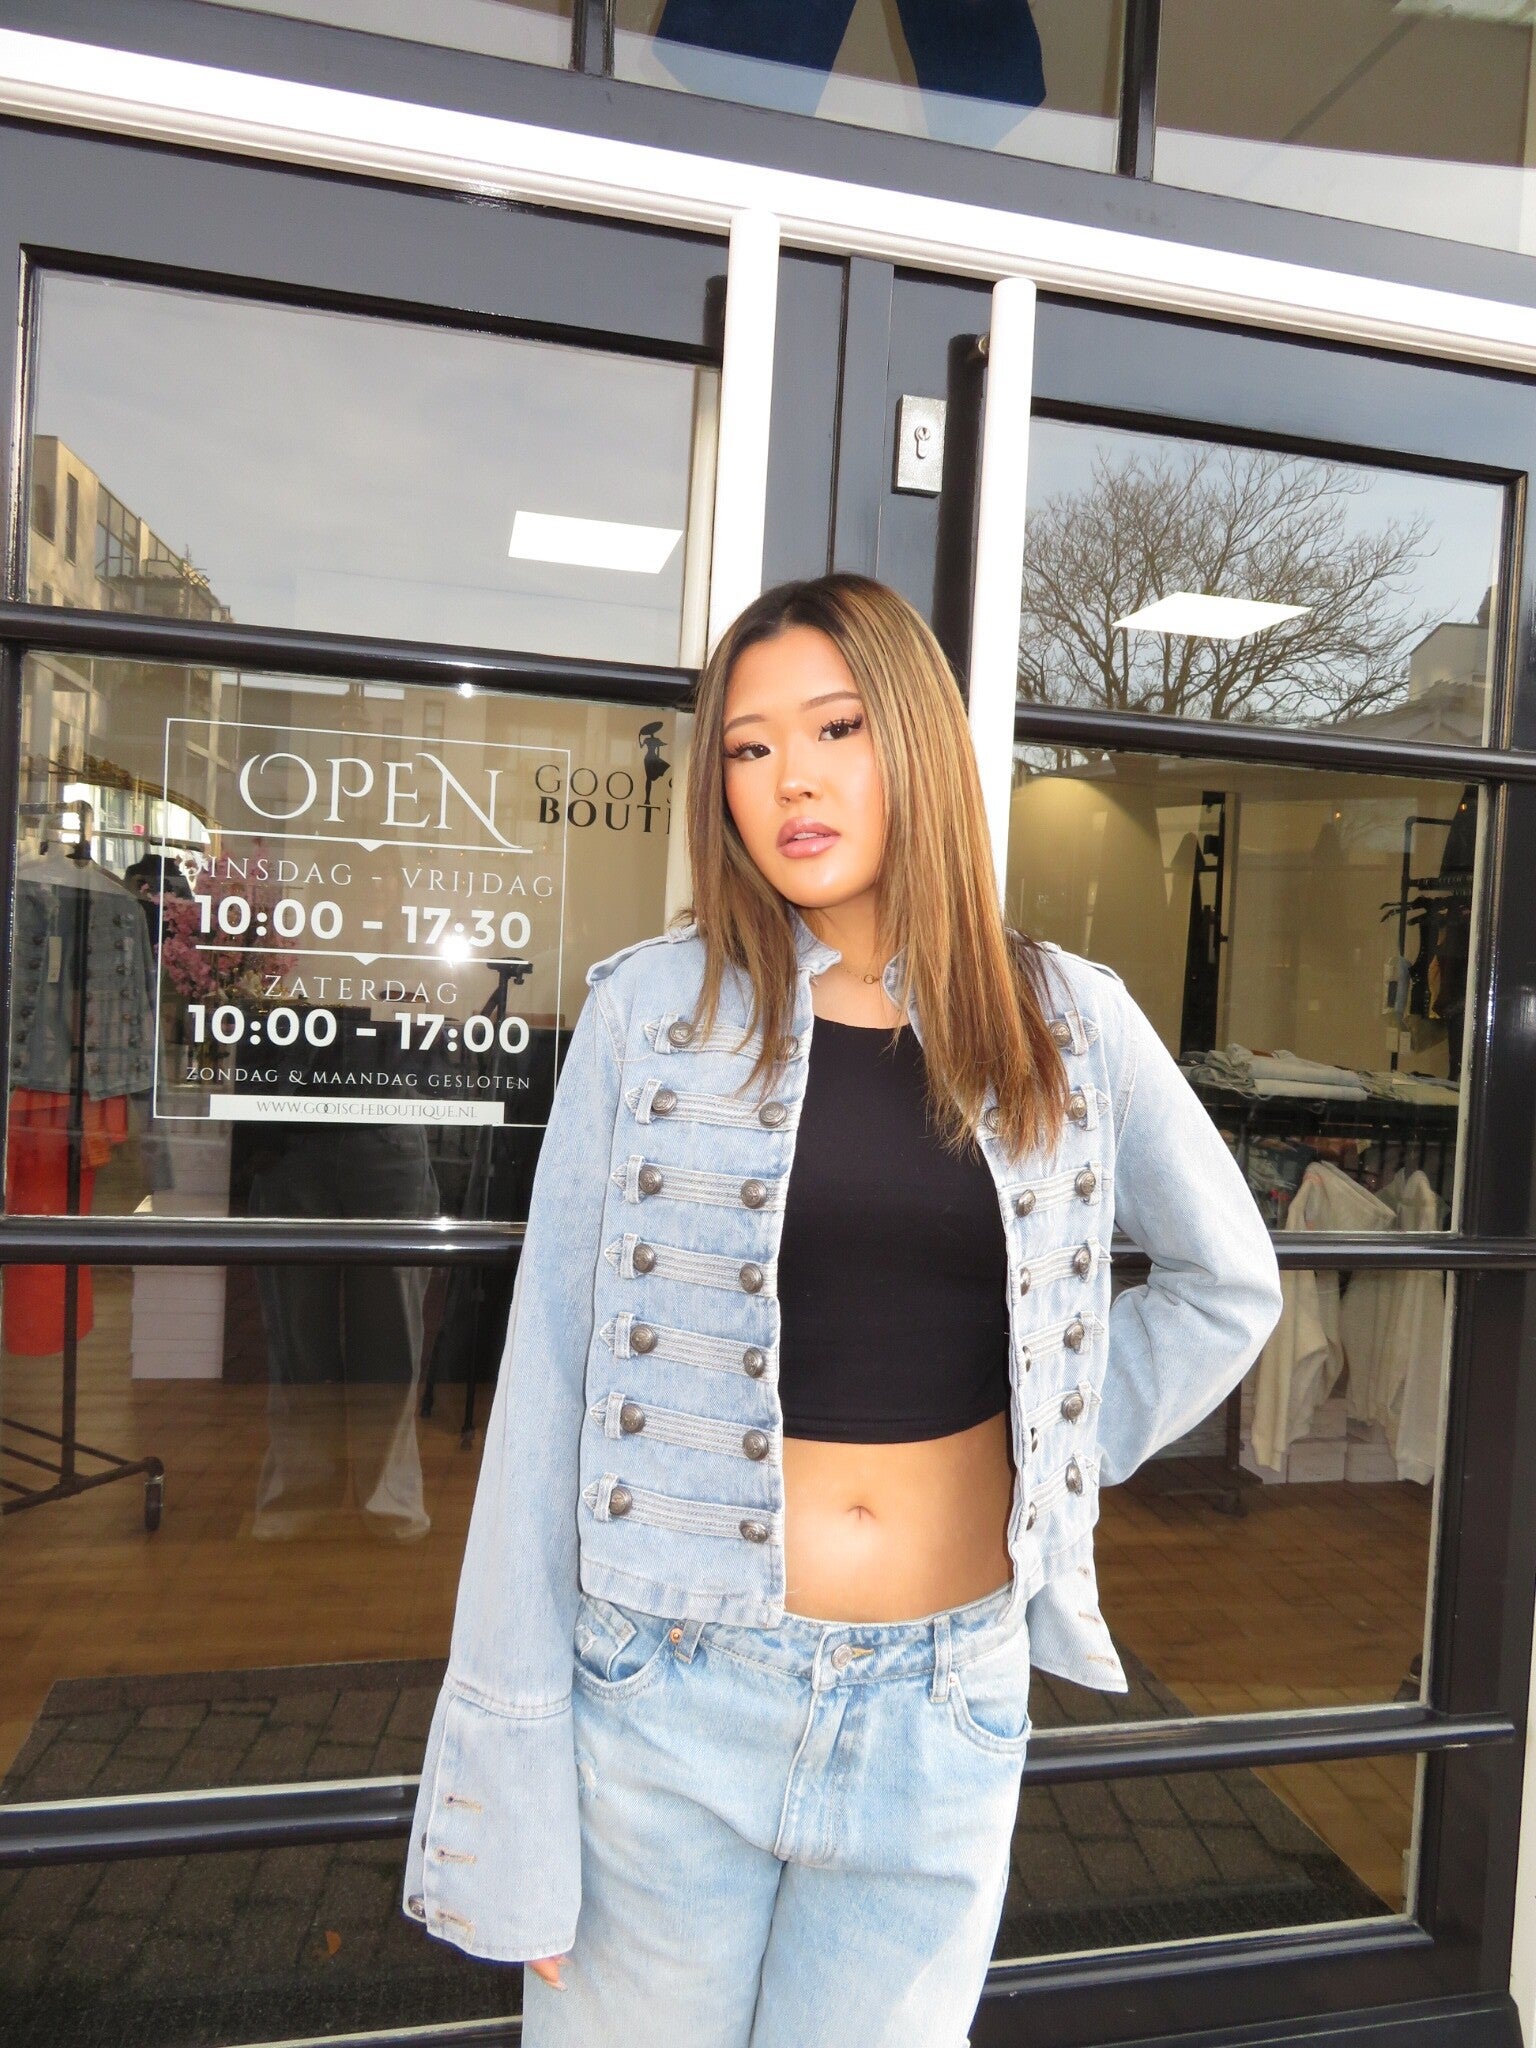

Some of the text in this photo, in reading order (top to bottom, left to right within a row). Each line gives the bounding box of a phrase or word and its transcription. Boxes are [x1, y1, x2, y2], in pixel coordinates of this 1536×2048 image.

[239, 752, 521, 848] OPEN
[538, 796, 671, 834] BOUT
[401, 867, 554, 898] VRIJDAG
[194, 895, 531, 949] 10:00 - 17:30
[264, 975, 458, 1004] ZATERDAG
[187, 1005, 529, 1054] 10:00 - 17:00
[186, 1068, 530, 1090] ZONDAG & MAANDAG GESLOTEN
[256, 1101, 478, 1120] WWW.GOOISCHEBOUTIQUE.NL
